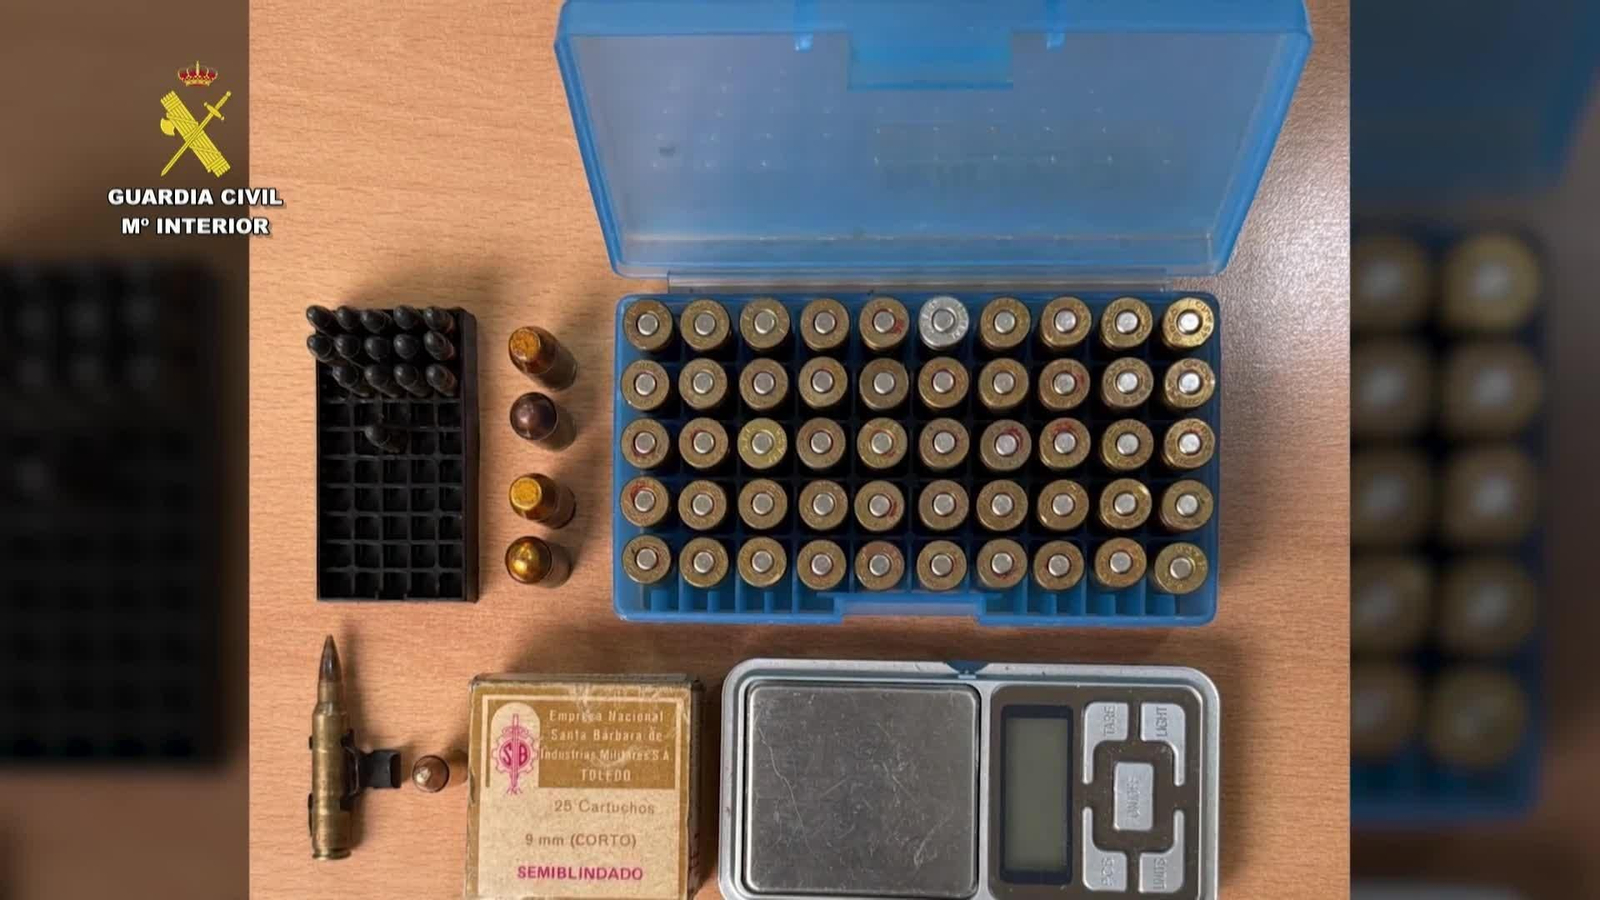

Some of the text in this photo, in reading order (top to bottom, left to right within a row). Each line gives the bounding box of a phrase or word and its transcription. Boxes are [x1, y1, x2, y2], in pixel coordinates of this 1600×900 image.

[608, 709, 664, 721] Nacional
[1103, 706, 1115, 737] TARE
[1156, 706, 1168, 737] LIGHT
[551, 728, 587, 741] Santa
[648, 728, 663, 741] de
[540, 749, 596, 760] Industrias
[581, 768, 631, 782] TOLEDO
[554, 799, 655, 815] 25 Cartuchos
[525, 833, 637, 848] 9 mm (CORTO)
[517, 865, 644, 881] SEMIBLINDADO
[1153, 857, 1168, 890] UNITS
